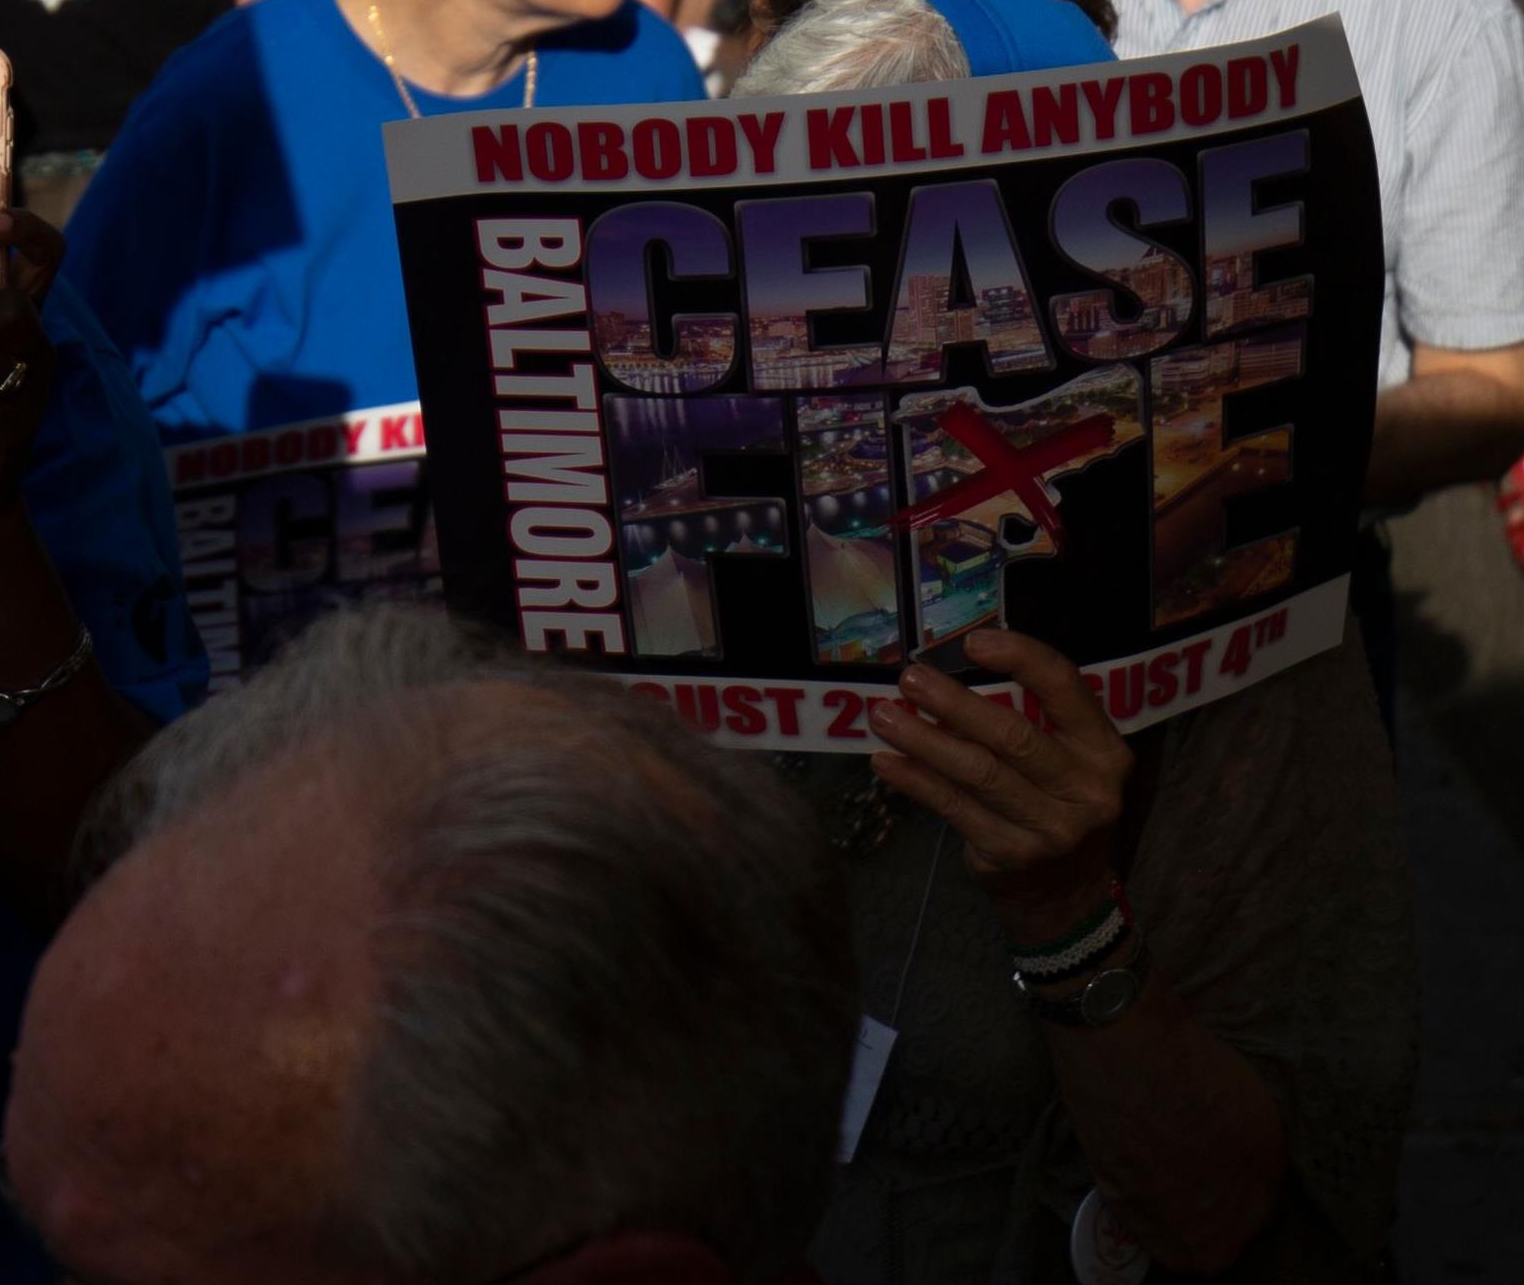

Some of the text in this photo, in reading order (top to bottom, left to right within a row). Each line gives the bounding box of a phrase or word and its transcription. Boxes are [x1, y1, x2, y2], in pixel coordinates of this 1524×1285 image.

[472, 44, 1301, 184] NOBODY KILL ANYBODY
[584, 129, 1315, 395] CEASE
[176, 412, 425, 484] NOBODY KI
[474, 217, 627, 654] BALTIMORE
[174, 490, 243, 693] BALTIM
[1219, 608, 1288, 677] 4TH
